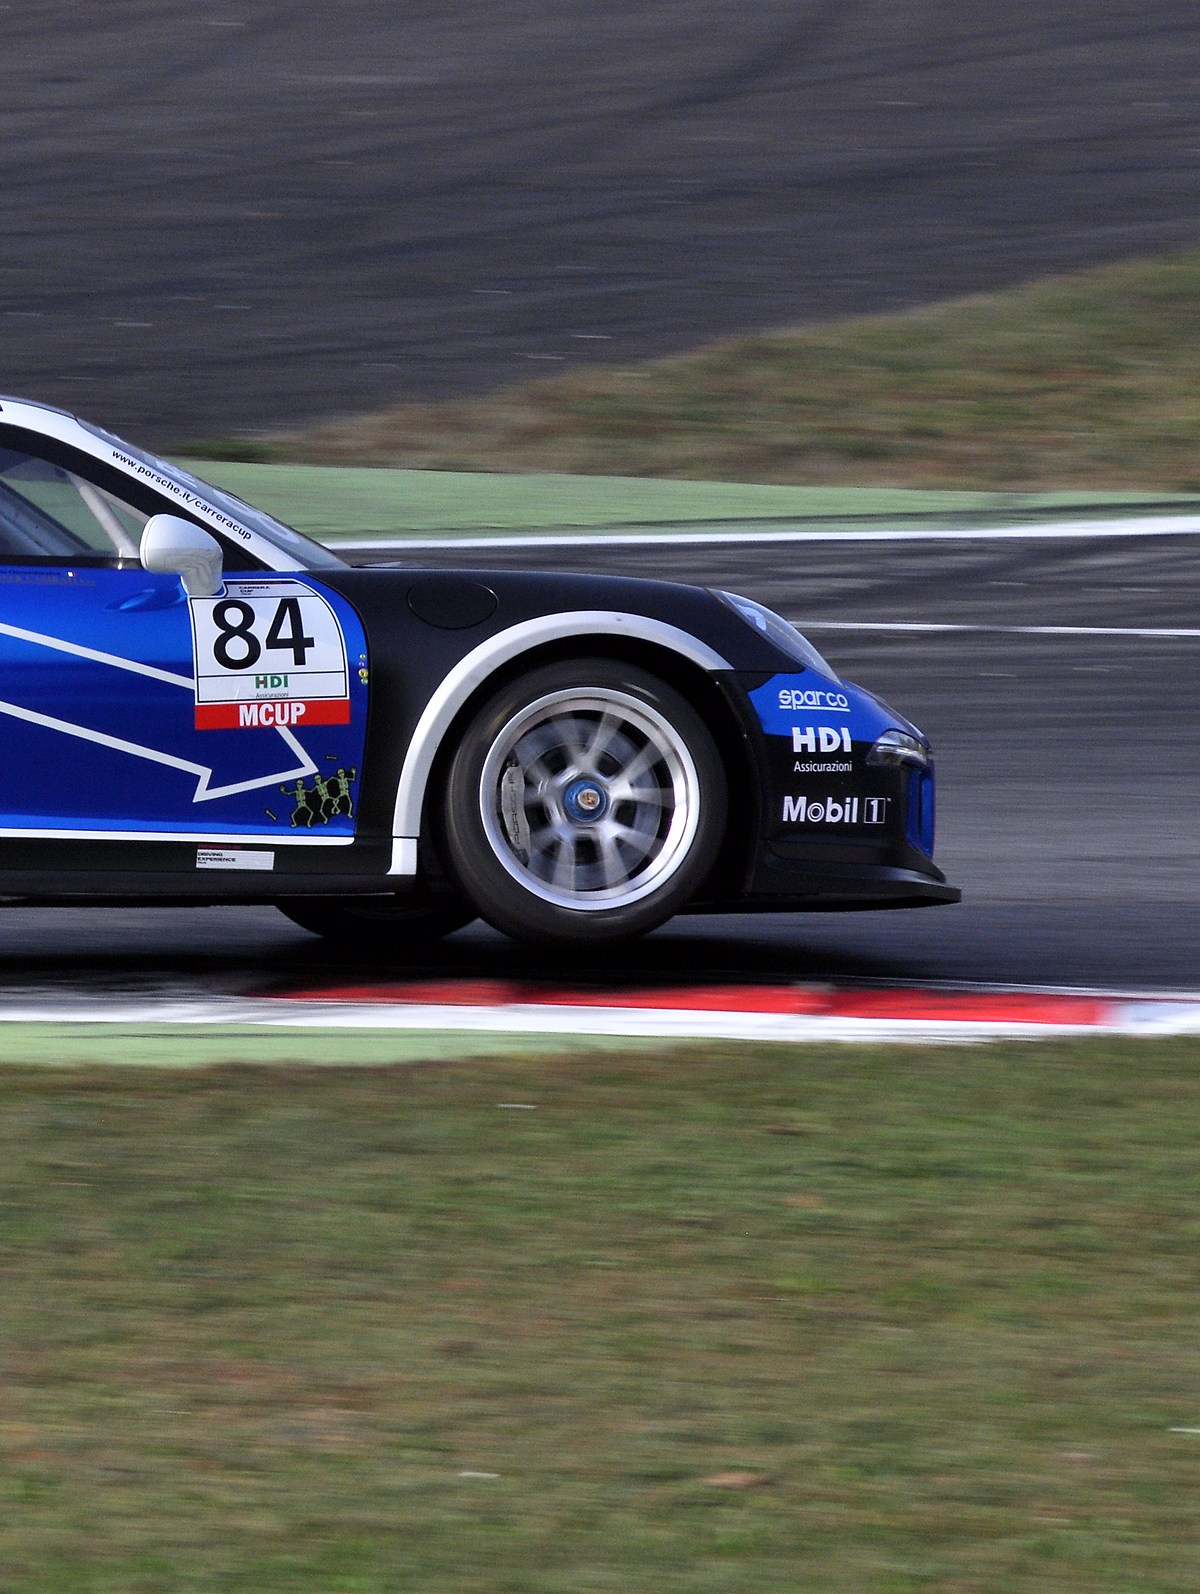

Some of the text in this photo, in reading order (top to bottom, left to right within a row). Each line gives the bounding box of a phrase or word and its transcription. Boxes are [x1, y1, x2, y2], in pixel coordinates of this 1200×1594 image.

[111, 449, 253, 541] www.porsche.it/carreracup
[212, 597, 315, 671] 84
[255, 675, 289, 689] HDI
[778, 689, 851, 712] sparco
[239, 703, 306, 727] MCUP
[792, 726, 853, 753] HDI
[793, 760, 853, 773] Assicurazioni
[782, 795, 859, 823] Mobil
